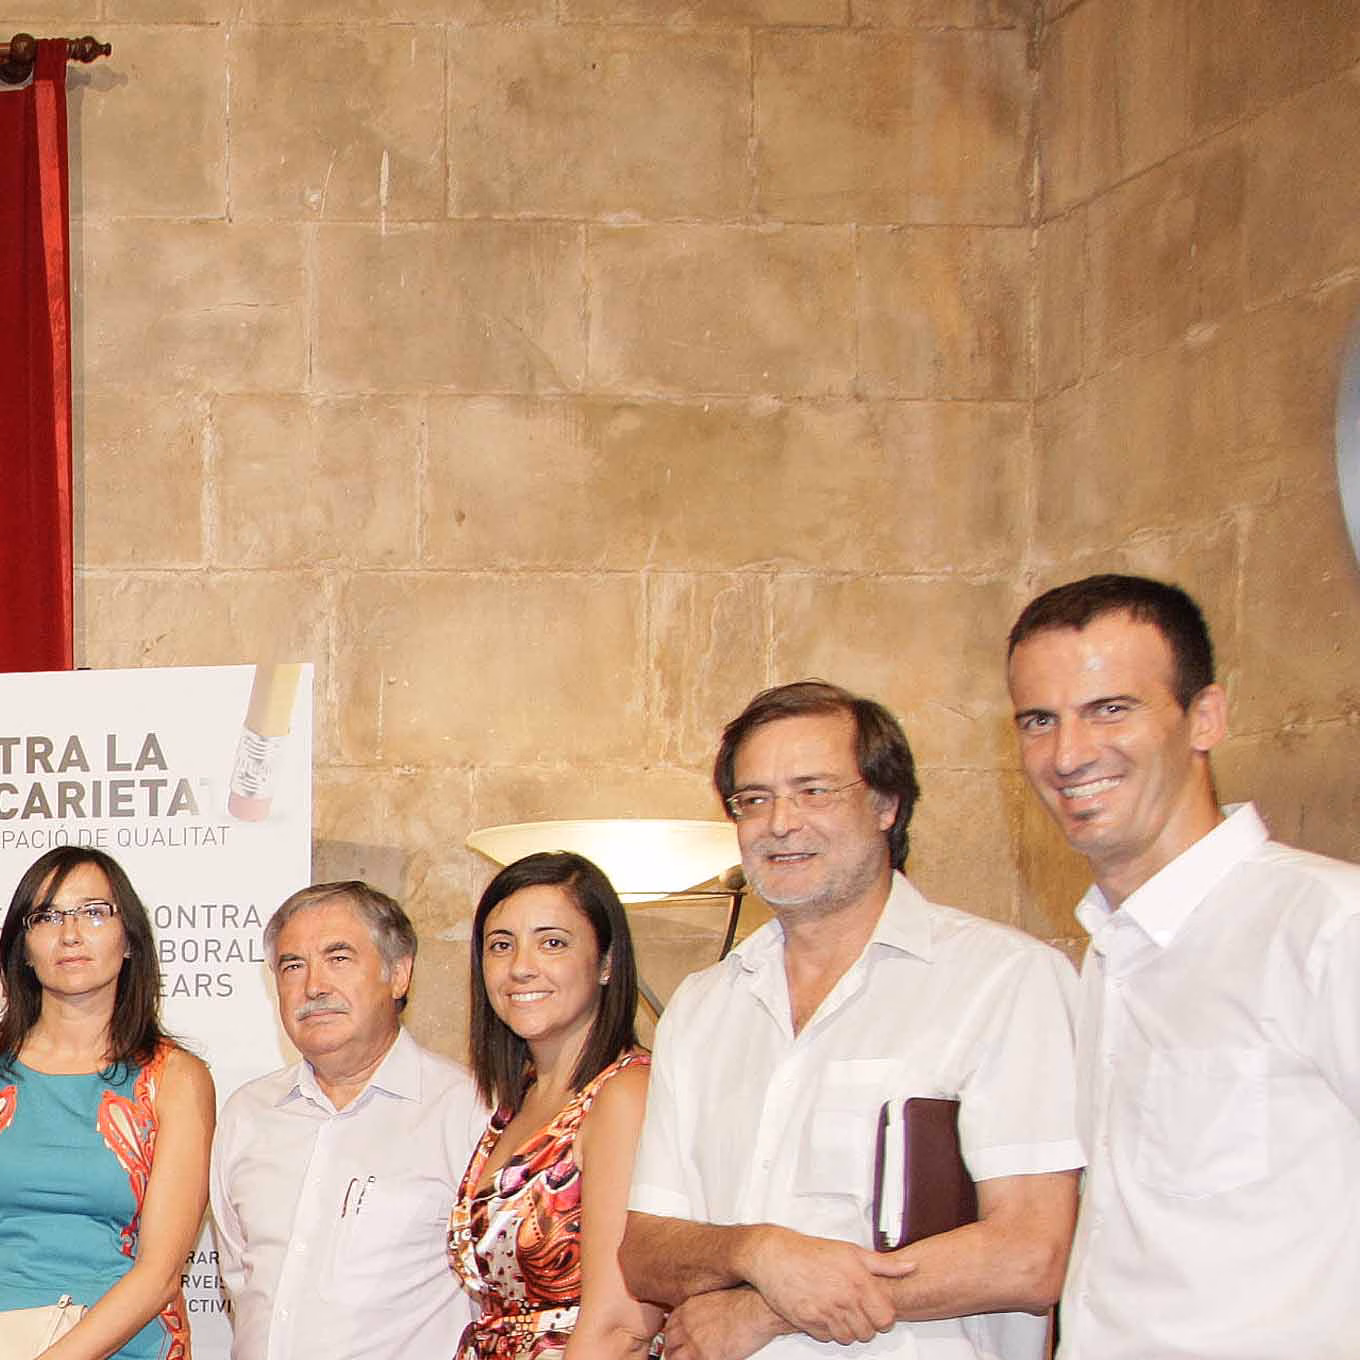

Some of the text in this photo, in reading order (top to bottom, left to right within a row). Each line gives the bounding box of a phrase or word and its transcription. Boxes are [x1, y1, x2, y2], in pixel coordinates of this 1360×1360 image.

[106, 733, 168, 772] LA
[79, 829, 108, 848] DE
[117, 826, 230, 848] QUALITAT
[154, 904, 262, 929] ONTRA
[159, 938, 264, 963] BORAL
[159, 972, 233, 997] EARS
[186, 1250, 219, 1265] RAR
[188, 1299, 231, 1313] CTIVI
